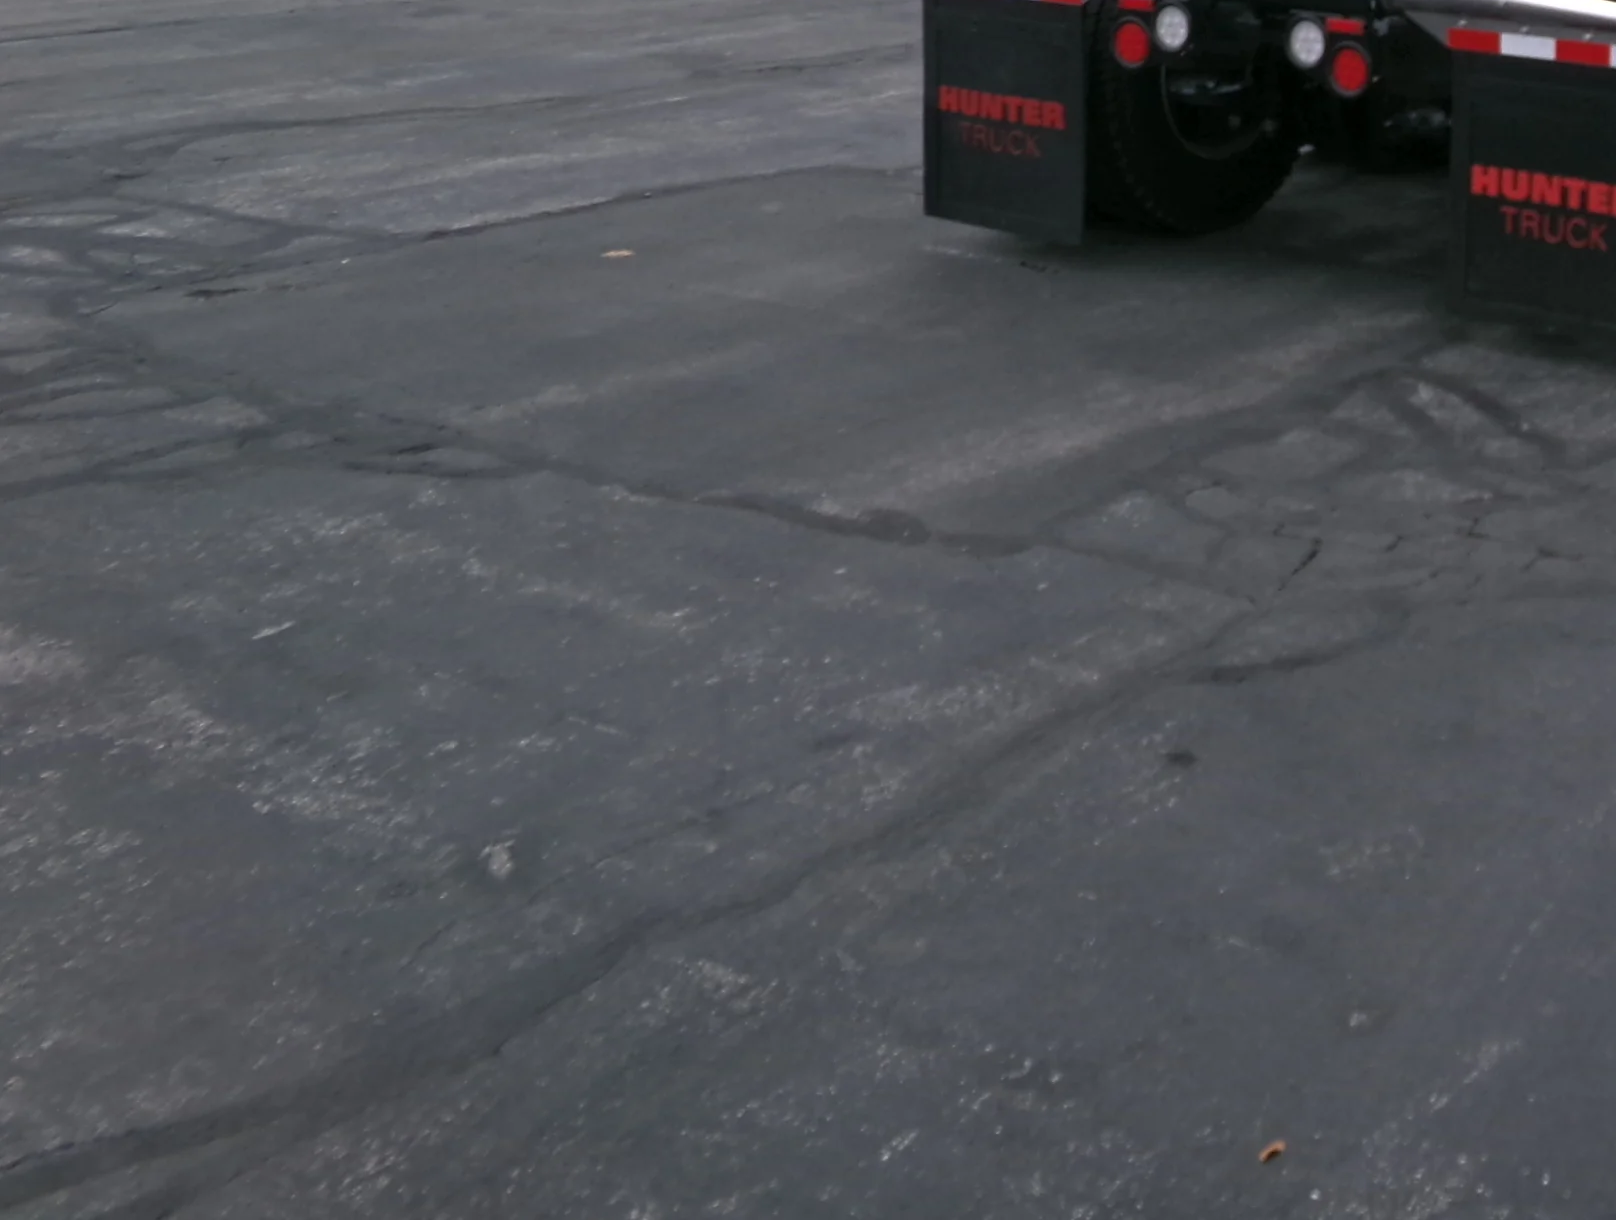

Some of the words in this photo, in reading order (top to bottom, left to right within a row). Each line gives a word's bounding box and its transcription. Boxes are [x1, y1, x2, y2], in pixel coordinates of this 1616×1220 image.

[938, 84, 1067, 130] HUNTER
[958, 121, 1042, 157] TRUCK
[1500, 205, 1609, 252] TRUCK
